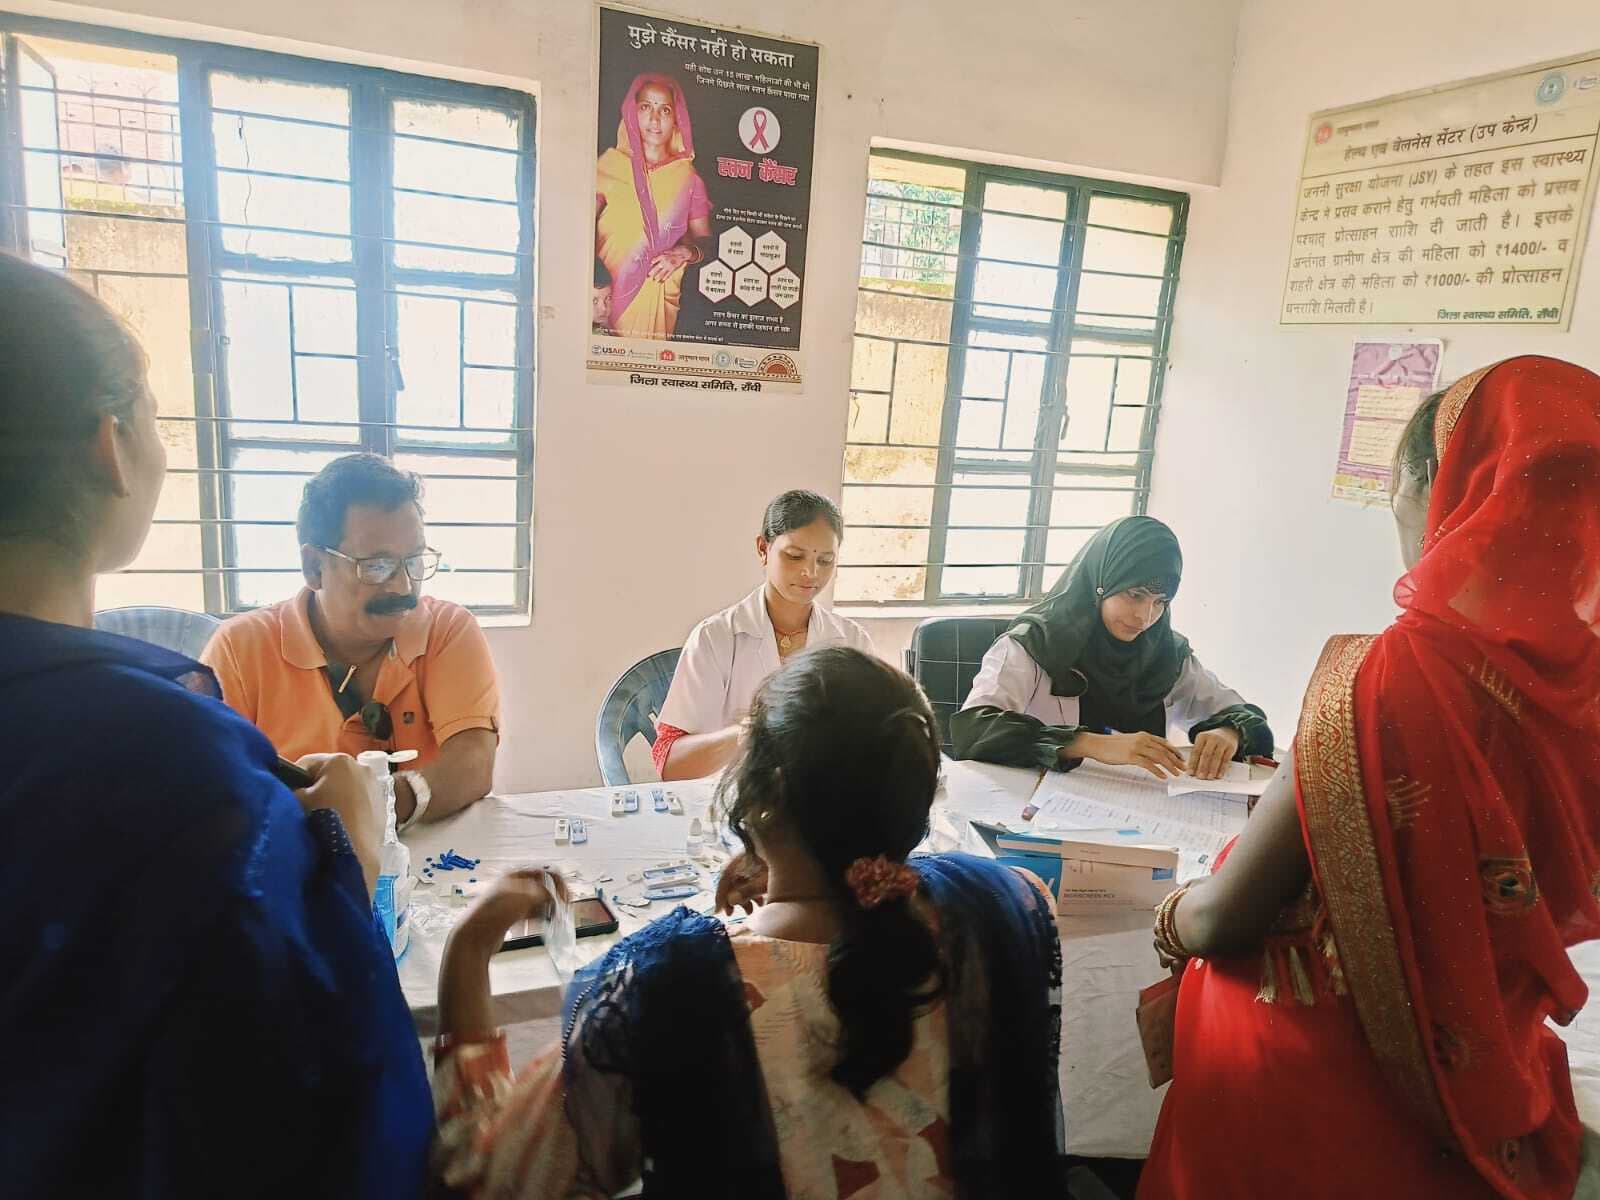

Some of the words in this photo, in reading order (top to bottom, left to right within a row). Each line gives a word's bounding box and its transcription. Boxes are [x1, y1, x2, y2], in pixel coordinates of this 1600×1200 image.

[628, 24, 655, 48] मुझे
[660, 27, 698, 52] कैंसर
[700, 38, 728, 58] नहीं
[731, 41, 746, 60] हो
[750, 48, 794, 68] सकता
[784, 78, 792, 87] की
[1392, 133, 1430, 152] वेलनेस
[1436, 125, 1463, 146] सेंटर
[1470, 123, 1495, 144] (उप
[1502, 114, 1538, 135] केन्द्र)
[758, 158, 798, 186] कैंसर
[1304, 182, 1330, 198] जननी
[1336, 179, 1362, 200] सुरक्षा
[1368, 174, 1402, 189] योजना
[1409, 170, 1437, 188] (JSY)
[1444, 163, 1456, 180] के
[1464, 161, 1493, 177] तहत
[1502, 157, 1523, 174] इस
[1533, 149, 1587, 168] स्वास्थ्य
[1336, 204, 1358, 219] प्रसव
[1362, 197, 1392, 215] कराने
[1397, 196, 1414, 216] हेतु
[1420, 189, 1462, 208] गर्भवती
[1469, 185, 1510, 204] महिला
[1518, 179, 1537, 198] को
[1544, 179, 1580, 196] प्रसव
[1335, 226, 1378, 242] प्रोत्साहन
[1430, 218, 1443, 235] दी
[1456, 213, 1488, 232] जाती
[1535, 205, 1574, 226] इसके
[1333, 250, 1364, 267] ग्रामीण
[1371, 248, 1390, 265] क्षेत्र
[1398, 246, 1414, 263] की
[1422, 244, 1460, 263] महिला
[1469, 240, 1485, 258] को
[1496, 241, 1547, 257] ₹1400/-
[1558, 238, 1570, 254] व
[1290, 276, 1313, 292] शहरी
[1318, 276, 1336, 290] क्षेत्र
[1342, 274, 1356, 290] की
[1362, 273, 1396, 290] महिला
[1402, 272, 1419, 288] को
[1425, 272, 1470, 288] ₹1000/-
[1476, 267, 1494, 285] की
[1502, 266, 1562, 284] प्रोत्साहन
[1324, 297, 1356, 314] मिलती
[1438, 309, 1460, 320] जिला
[630, 374, 658, 386] जिला
[662, 378, 698, 388] स्वास्थ्य
